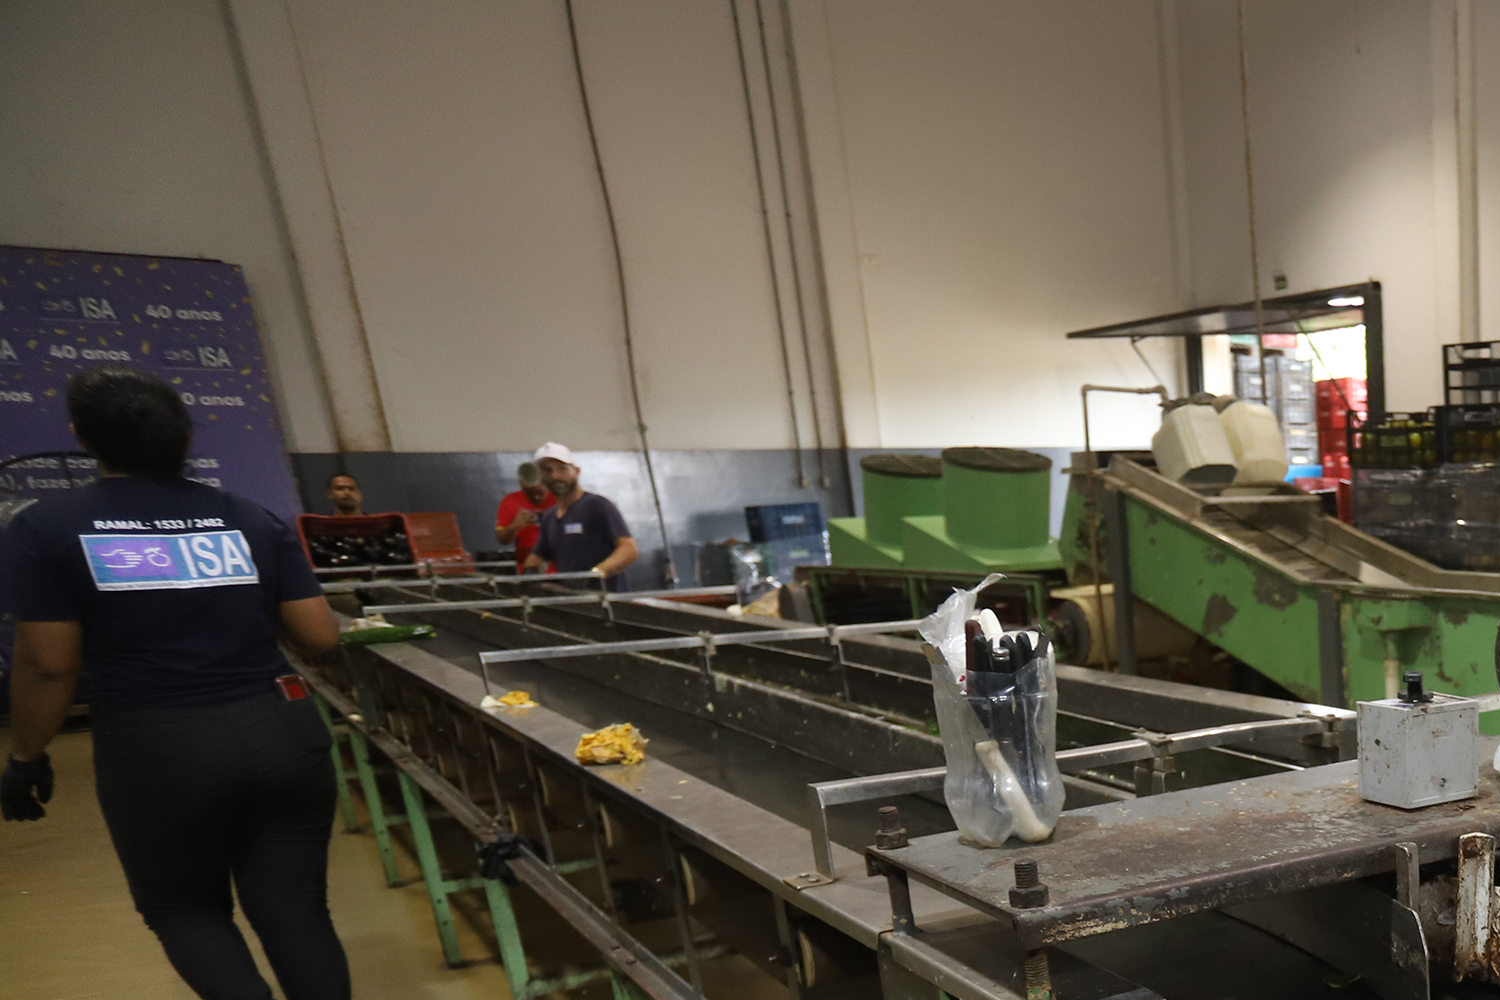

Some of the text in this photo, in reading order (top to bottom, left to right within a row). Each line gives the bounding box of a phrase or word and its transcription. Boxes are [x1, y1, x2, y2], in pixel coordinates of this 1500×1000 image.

[79, 297, 118, 321] ISA
[145, 305, 223, 322] 40 anos
[50, 345, 131, 361] 40 anos
[197, 346, 232, 368] ISA
[200, 394, 245, 406] anos
[93, 520, 152, 531] RAMAL:
[177, 534, 251, 579] ISA
